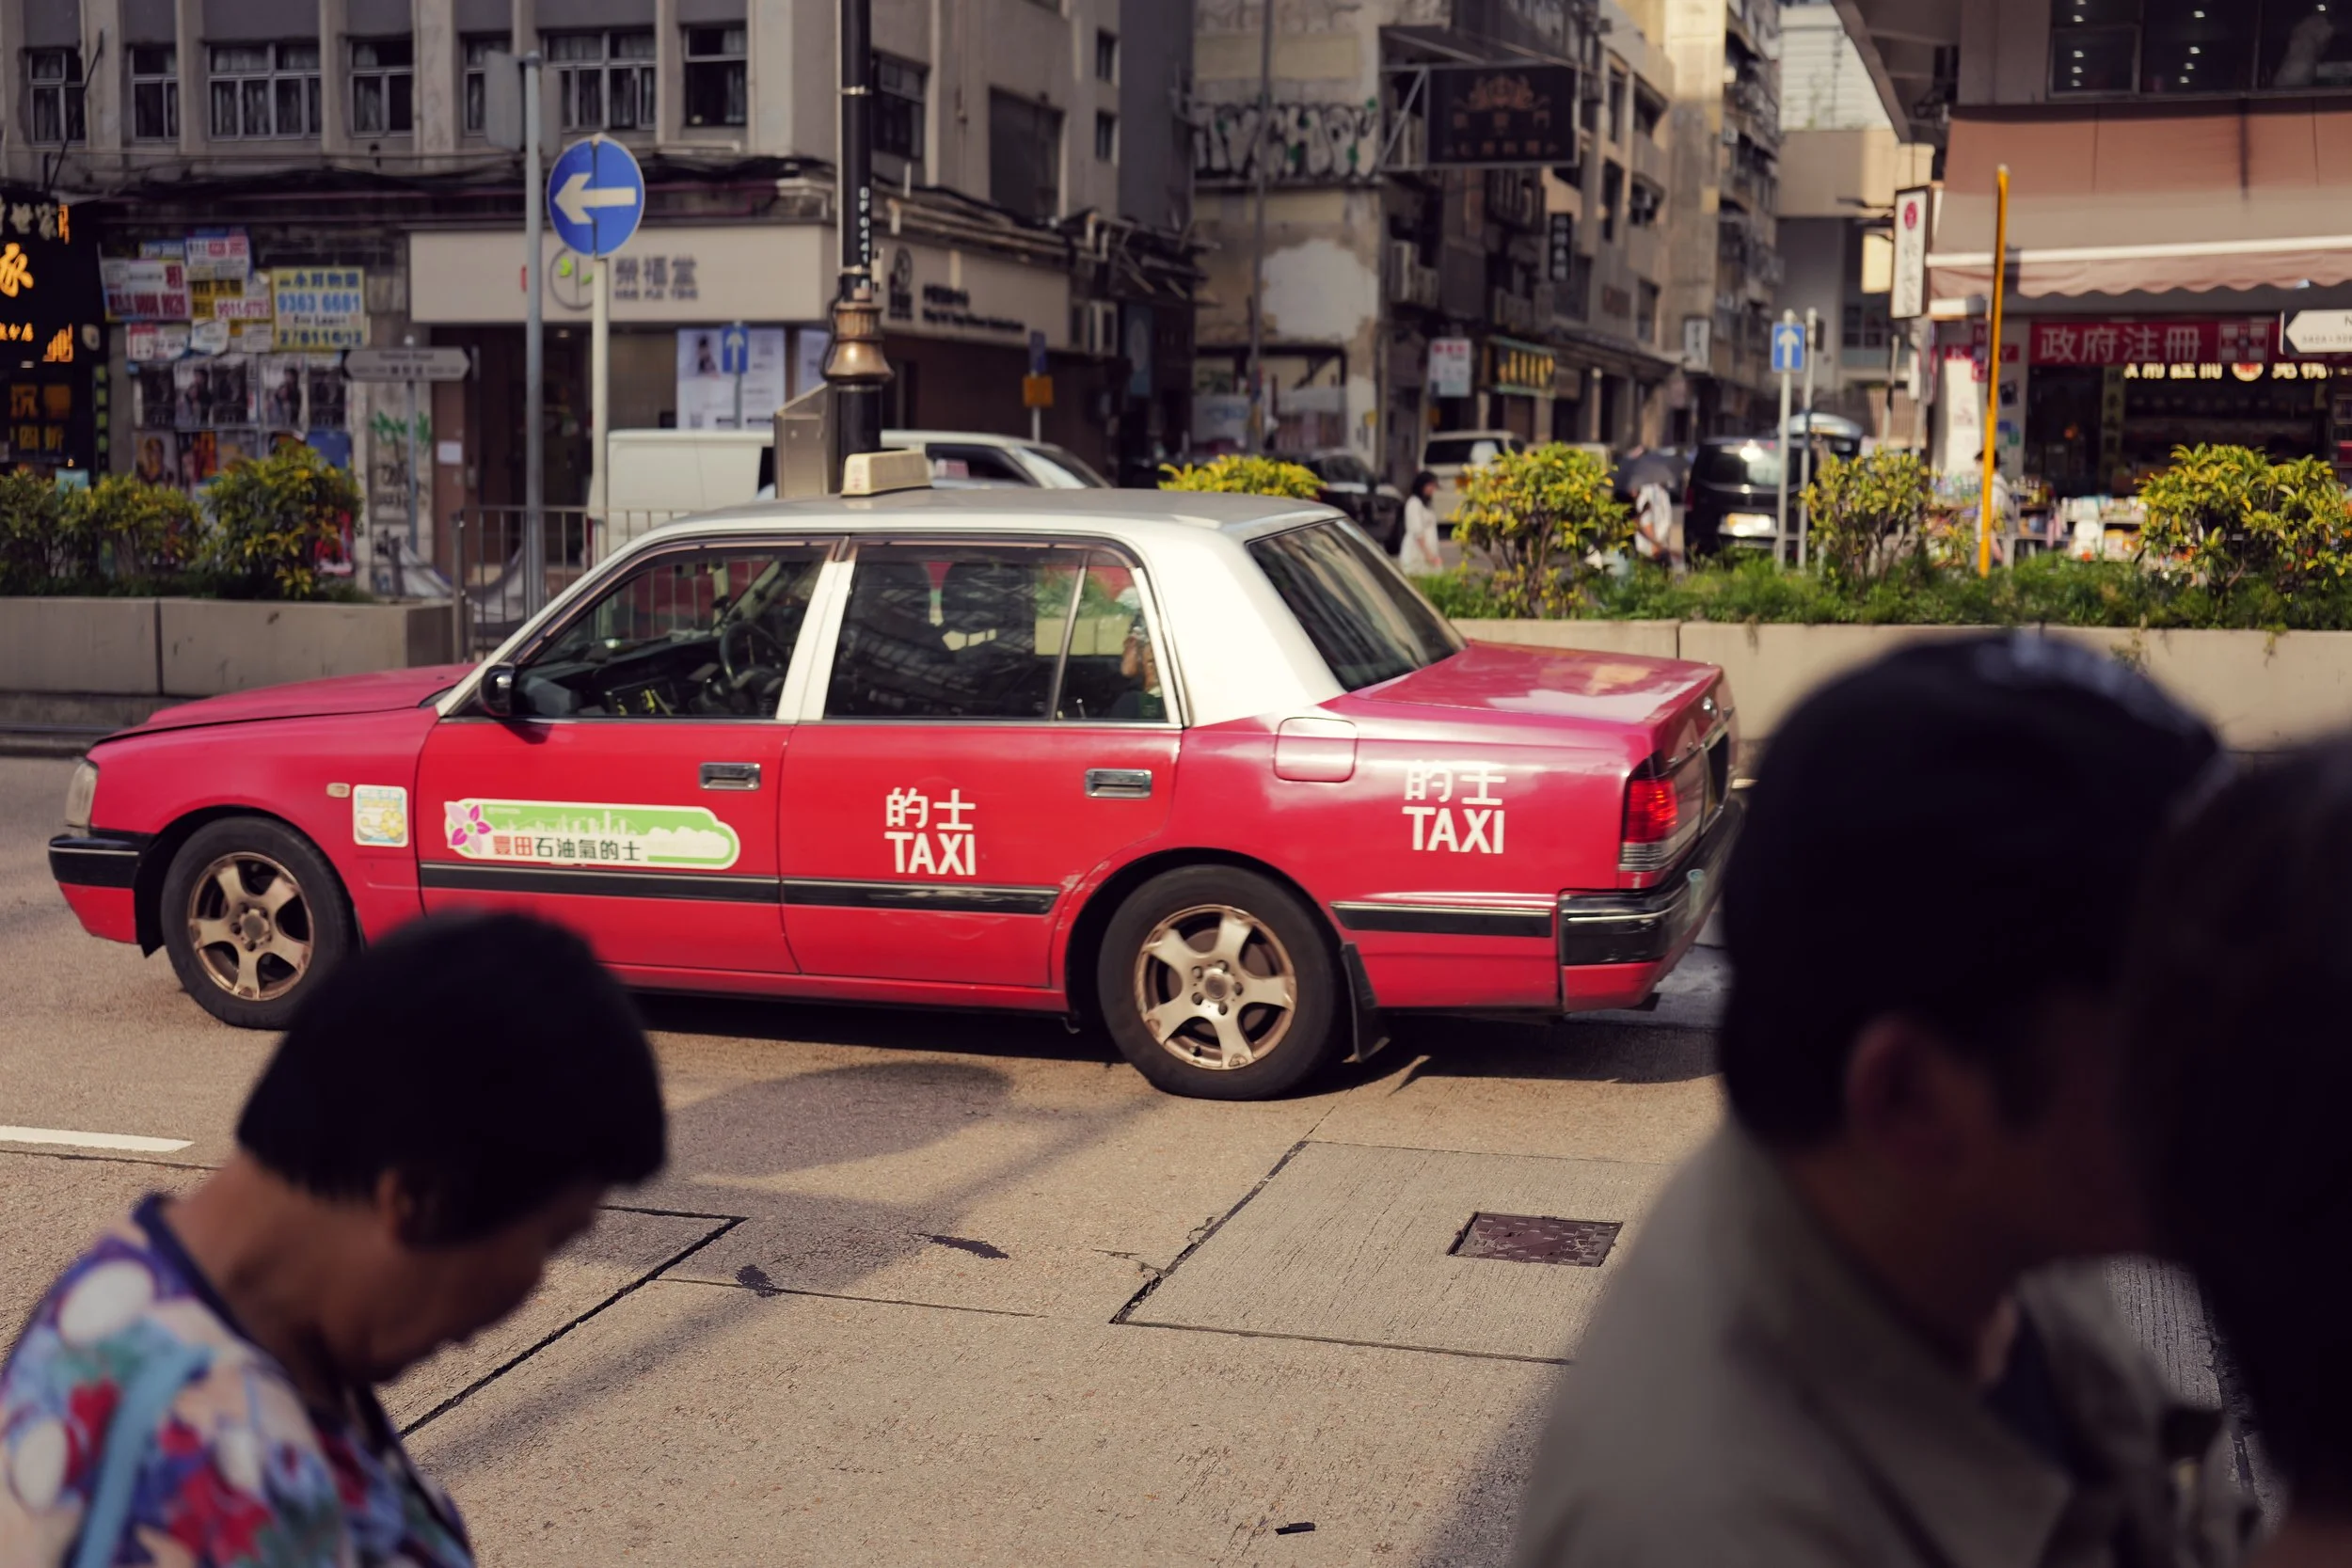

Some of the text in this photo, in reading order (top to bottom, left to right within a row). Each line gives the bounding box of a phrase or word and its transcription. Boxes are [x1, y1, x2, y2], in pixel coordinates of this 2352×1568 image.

[1405, 760, 1506, 805] 的士
[886, 786, 976, 831] 的士
[1402, 806, 1505, 854] TAXI
[884, 832, 976, 876] TAXI
